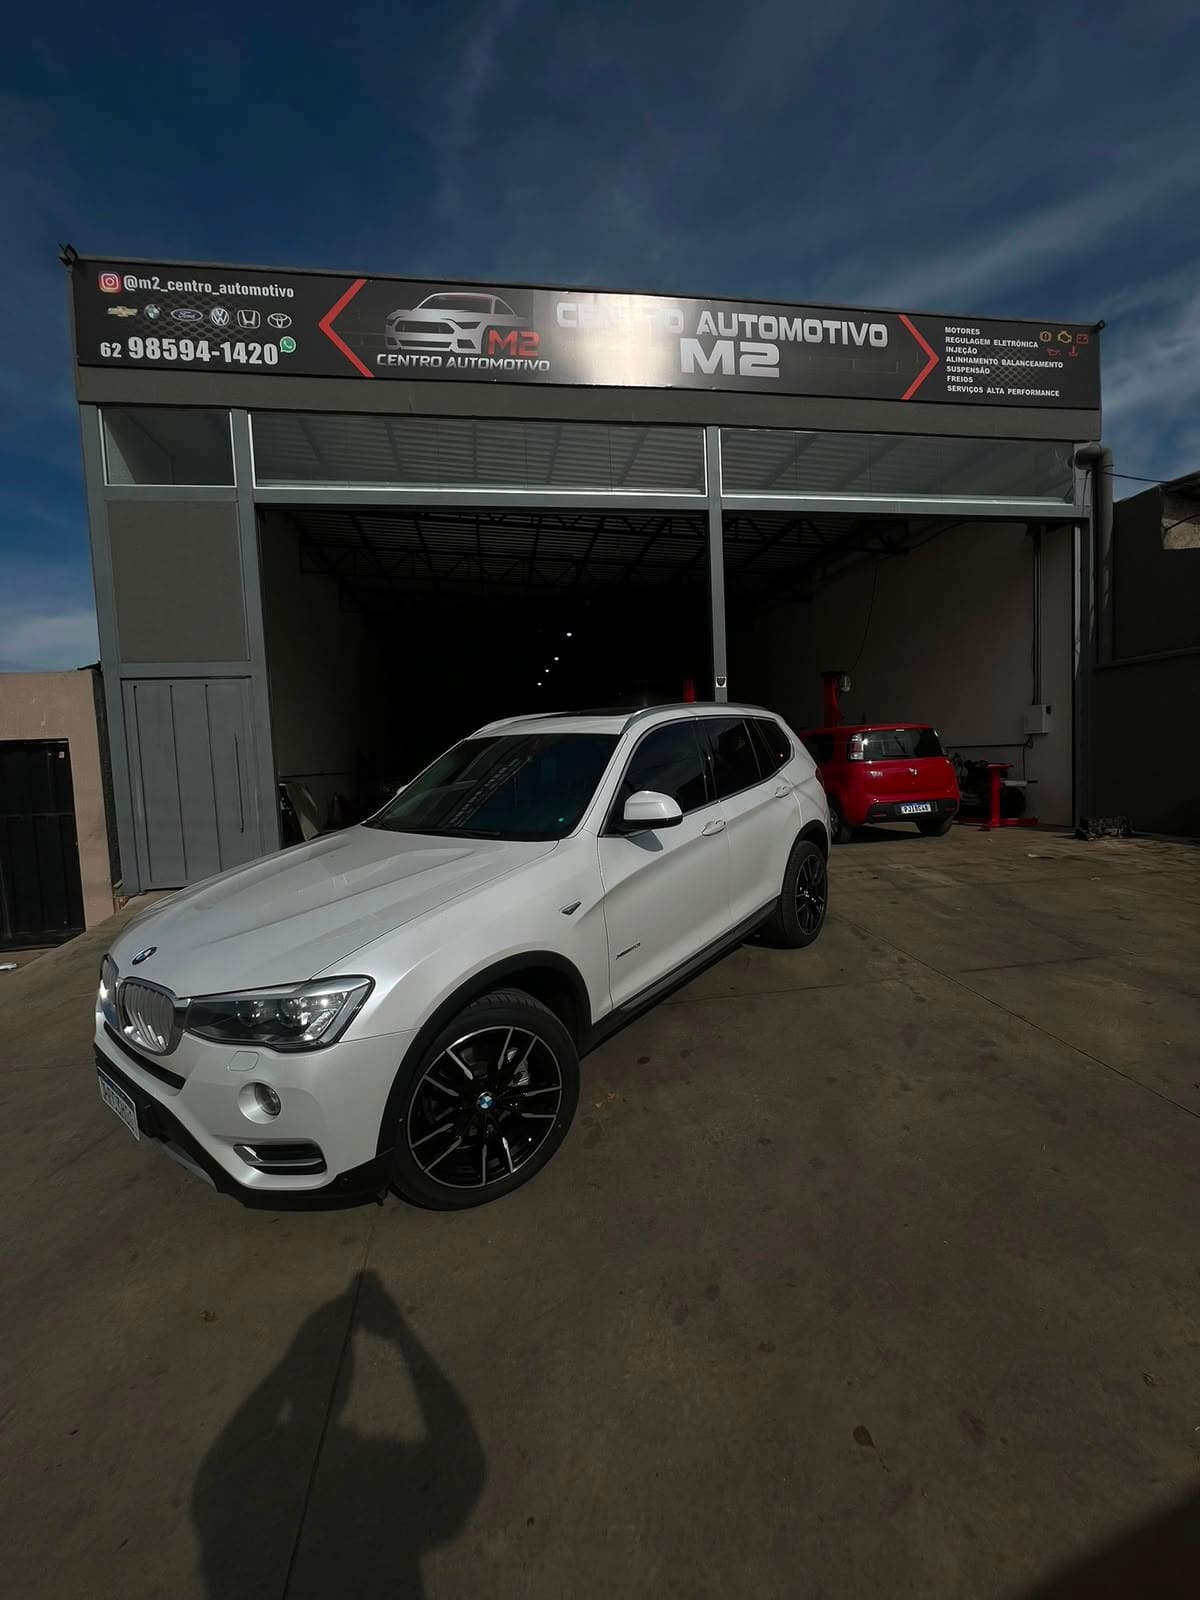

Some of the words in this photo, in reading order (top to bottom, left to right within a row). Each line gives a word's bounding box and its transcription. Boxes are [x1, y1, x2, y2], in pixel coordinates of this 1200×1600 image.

[123, 274, 294, 298] @m2_centro_automotivo
[696, 310, 888, 348] AUTOMOTIVO
[944, 327, 981, 335] MOTORES
[488, 329, 541, 357] M2
[945, 336, 991, 346] REGULAGEM
[993, 339, 1039, 349] ELETRÔNICA
[100, 342, 123, 358] 62
[128, 336, 279, 365] 98594-1420
[945, 346, 978, 355] INJEÇÃO
[377, 353, 443, 368] CENTRO
[446, 356, 550, 372] AUTOMOTIVO
[679, 337, 780, 378] M2
[946, 356, 999, 366] ALINHAMENTO
[1001, 358, 1064, 369] BALANCEAMENTO
[946, 365, 991, 375] SUSPENSÃO
[947, 375, 974, 383] FREIOS
[947, 385, 984, 394] SERVIÇOS
[986, 387, 1005, 395] ALTA
[1007, 388, 1060, 397] PERFORMANCE
